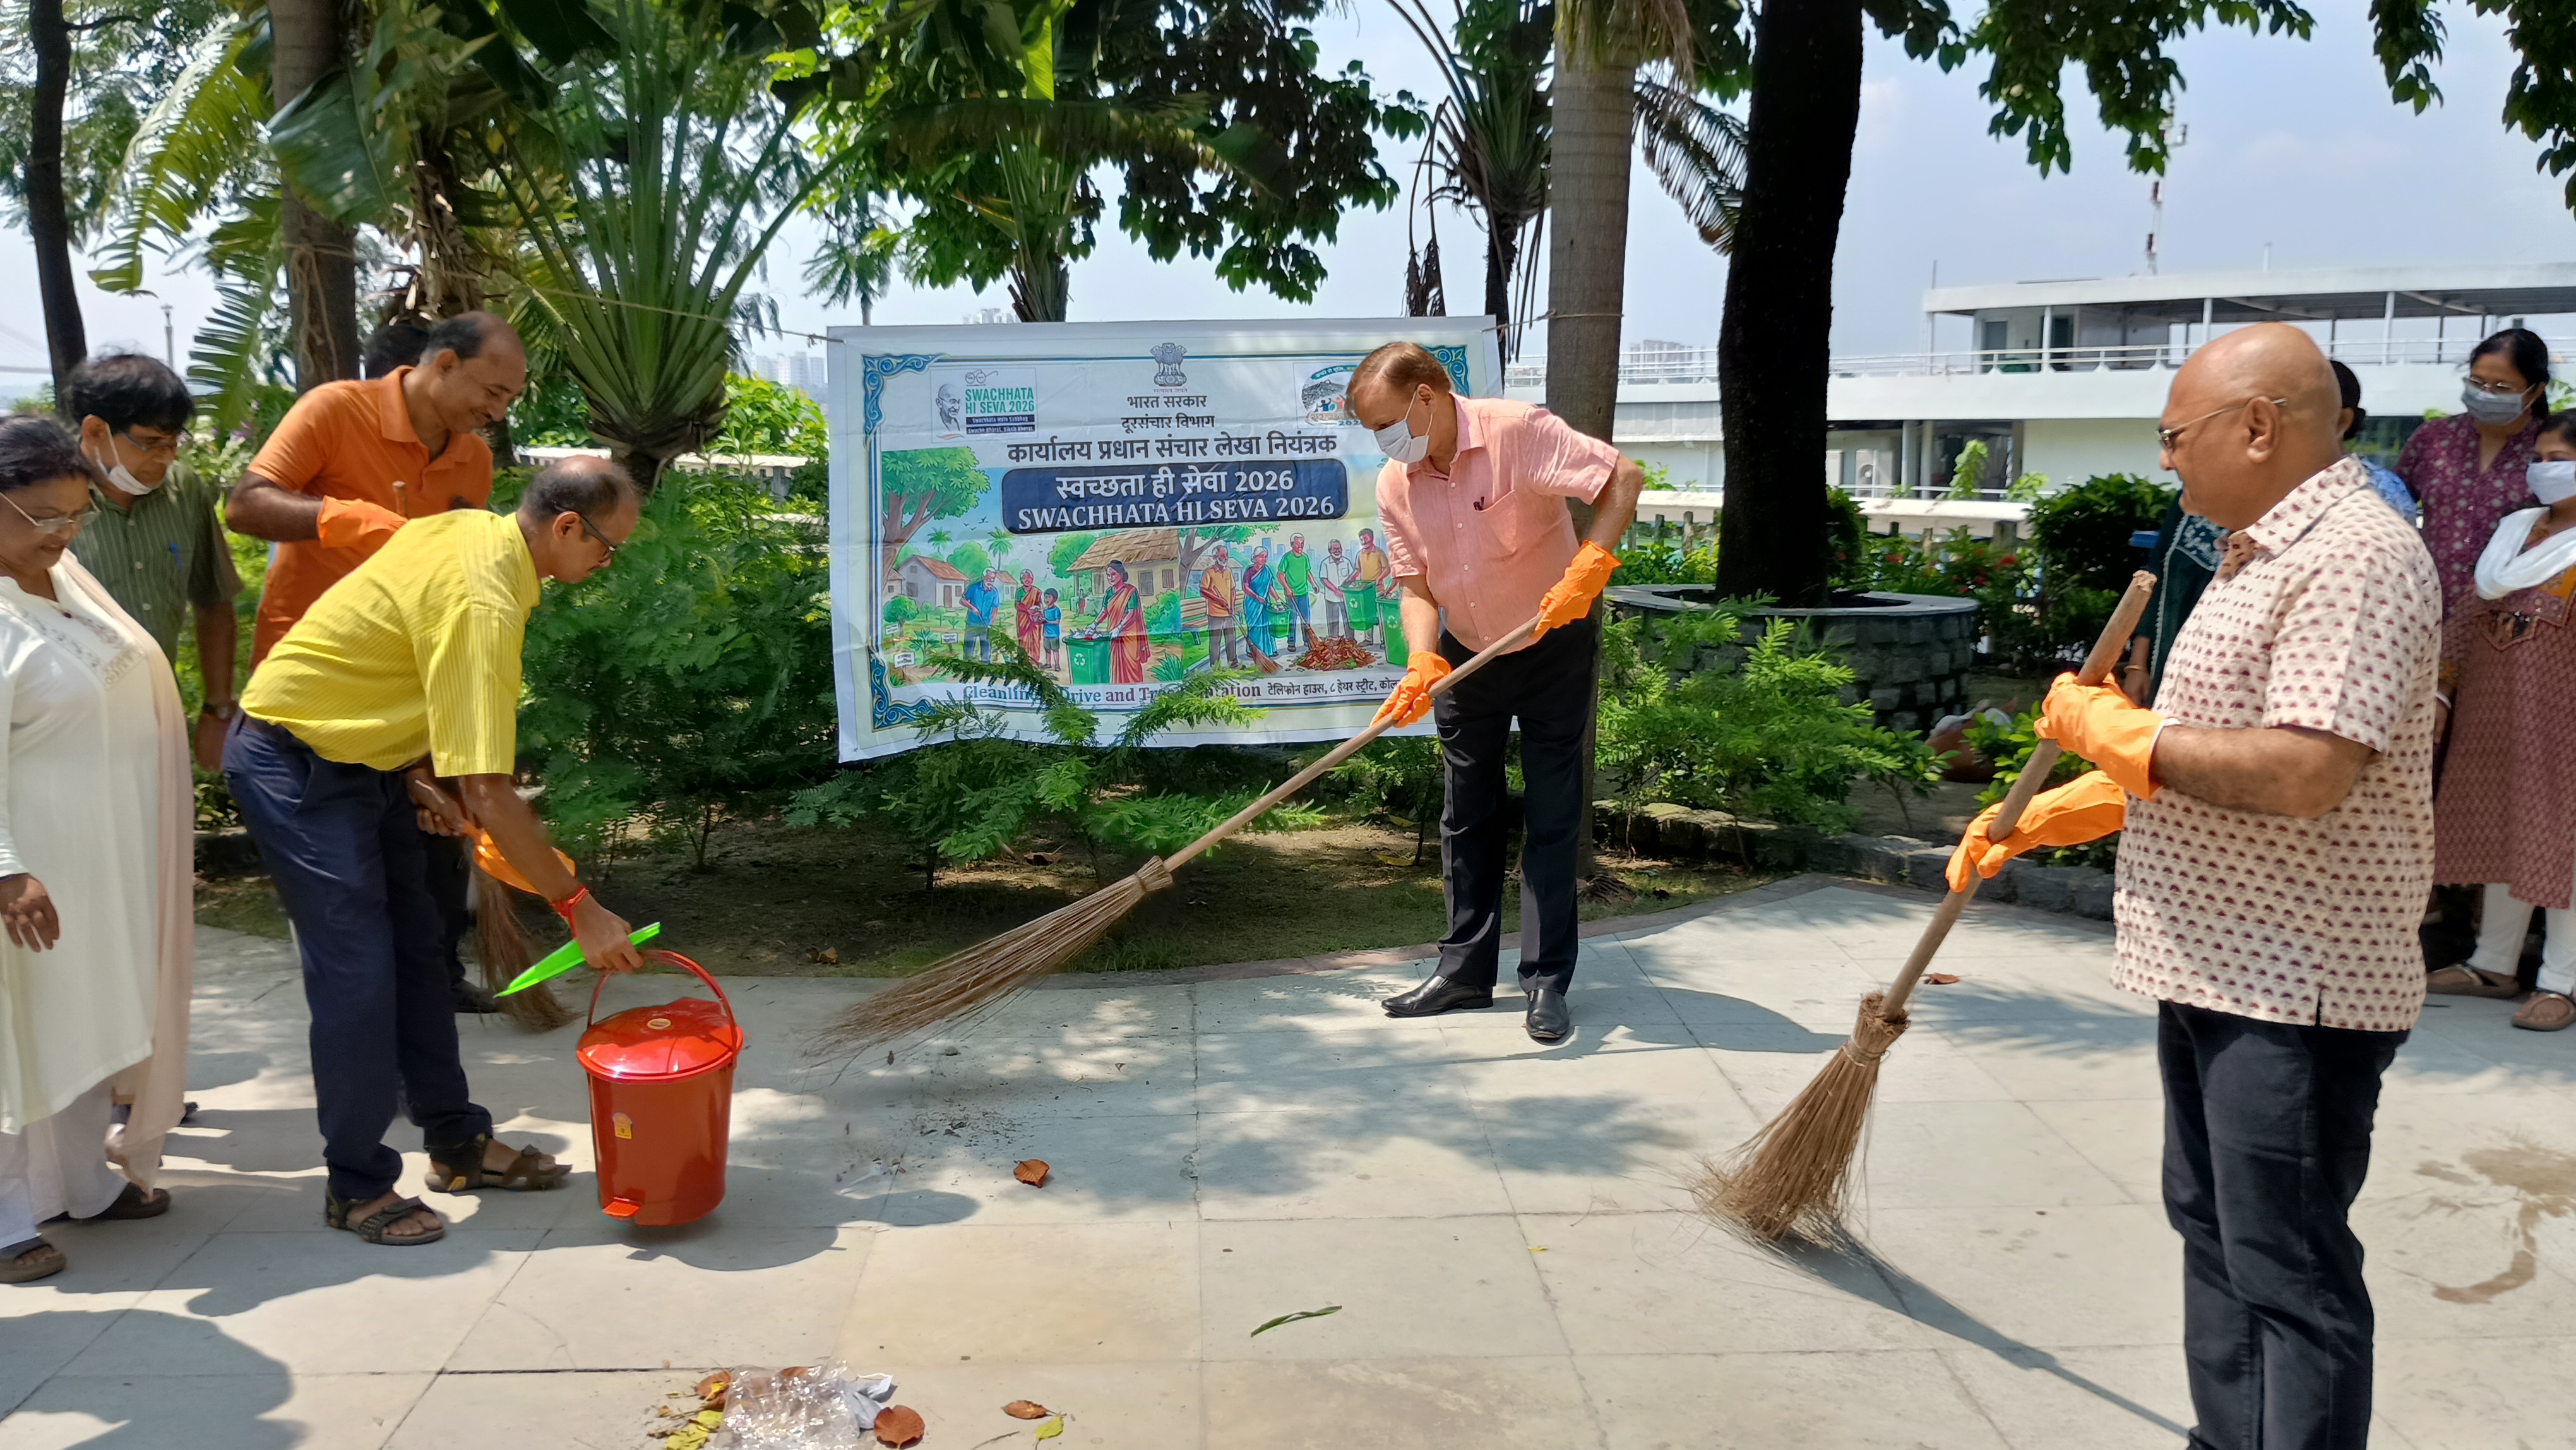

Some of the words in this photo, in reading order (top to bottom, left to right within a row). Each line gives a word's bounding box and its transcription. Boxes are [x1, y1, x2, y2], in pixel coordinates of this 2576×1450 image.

[965, 388, 1034, 402] SWACHHATA
[1127, 396, 1160, 408] भारत
[1163, 395, 1207, 407] सरकार
[965, 402, 976, 414] HI
[980, 402, 1006, 414] SEVA
[1010, 400, 1035, 412] 2026
[1121, 414, 1172, 434] दूरसंचार
[1176, 412, 1215, 428] विभाग
[1007, 436, 1092, 462] कार्यालय
[1098, 440, 1150, 460] प्रधान
[1155, 433, 1209, 458] संचार
[1214, 431, 1261, 455] लेखा
[1267, 430, 1337, 454] नियंत्रक
[1056, 474, 1145, 500] स्वच्छता
[1150, 466, 1176, 499] ही
[1181, 465, 1228, 494] सेवा
[1234, 470, 1294, 492] 2026
[1018, 503, 1171, 530] SWACHHATA
[1176, 501, 1203, 522] HI
[1210, 498, 1270, 520] SEVA
[1275, 496, 1335, 517] 2026
[1106, 688, 1135, 702] and
[1267, 682, 1301, 695] टेलिफोन
[1337, 680, 1353, 693] हेयर
